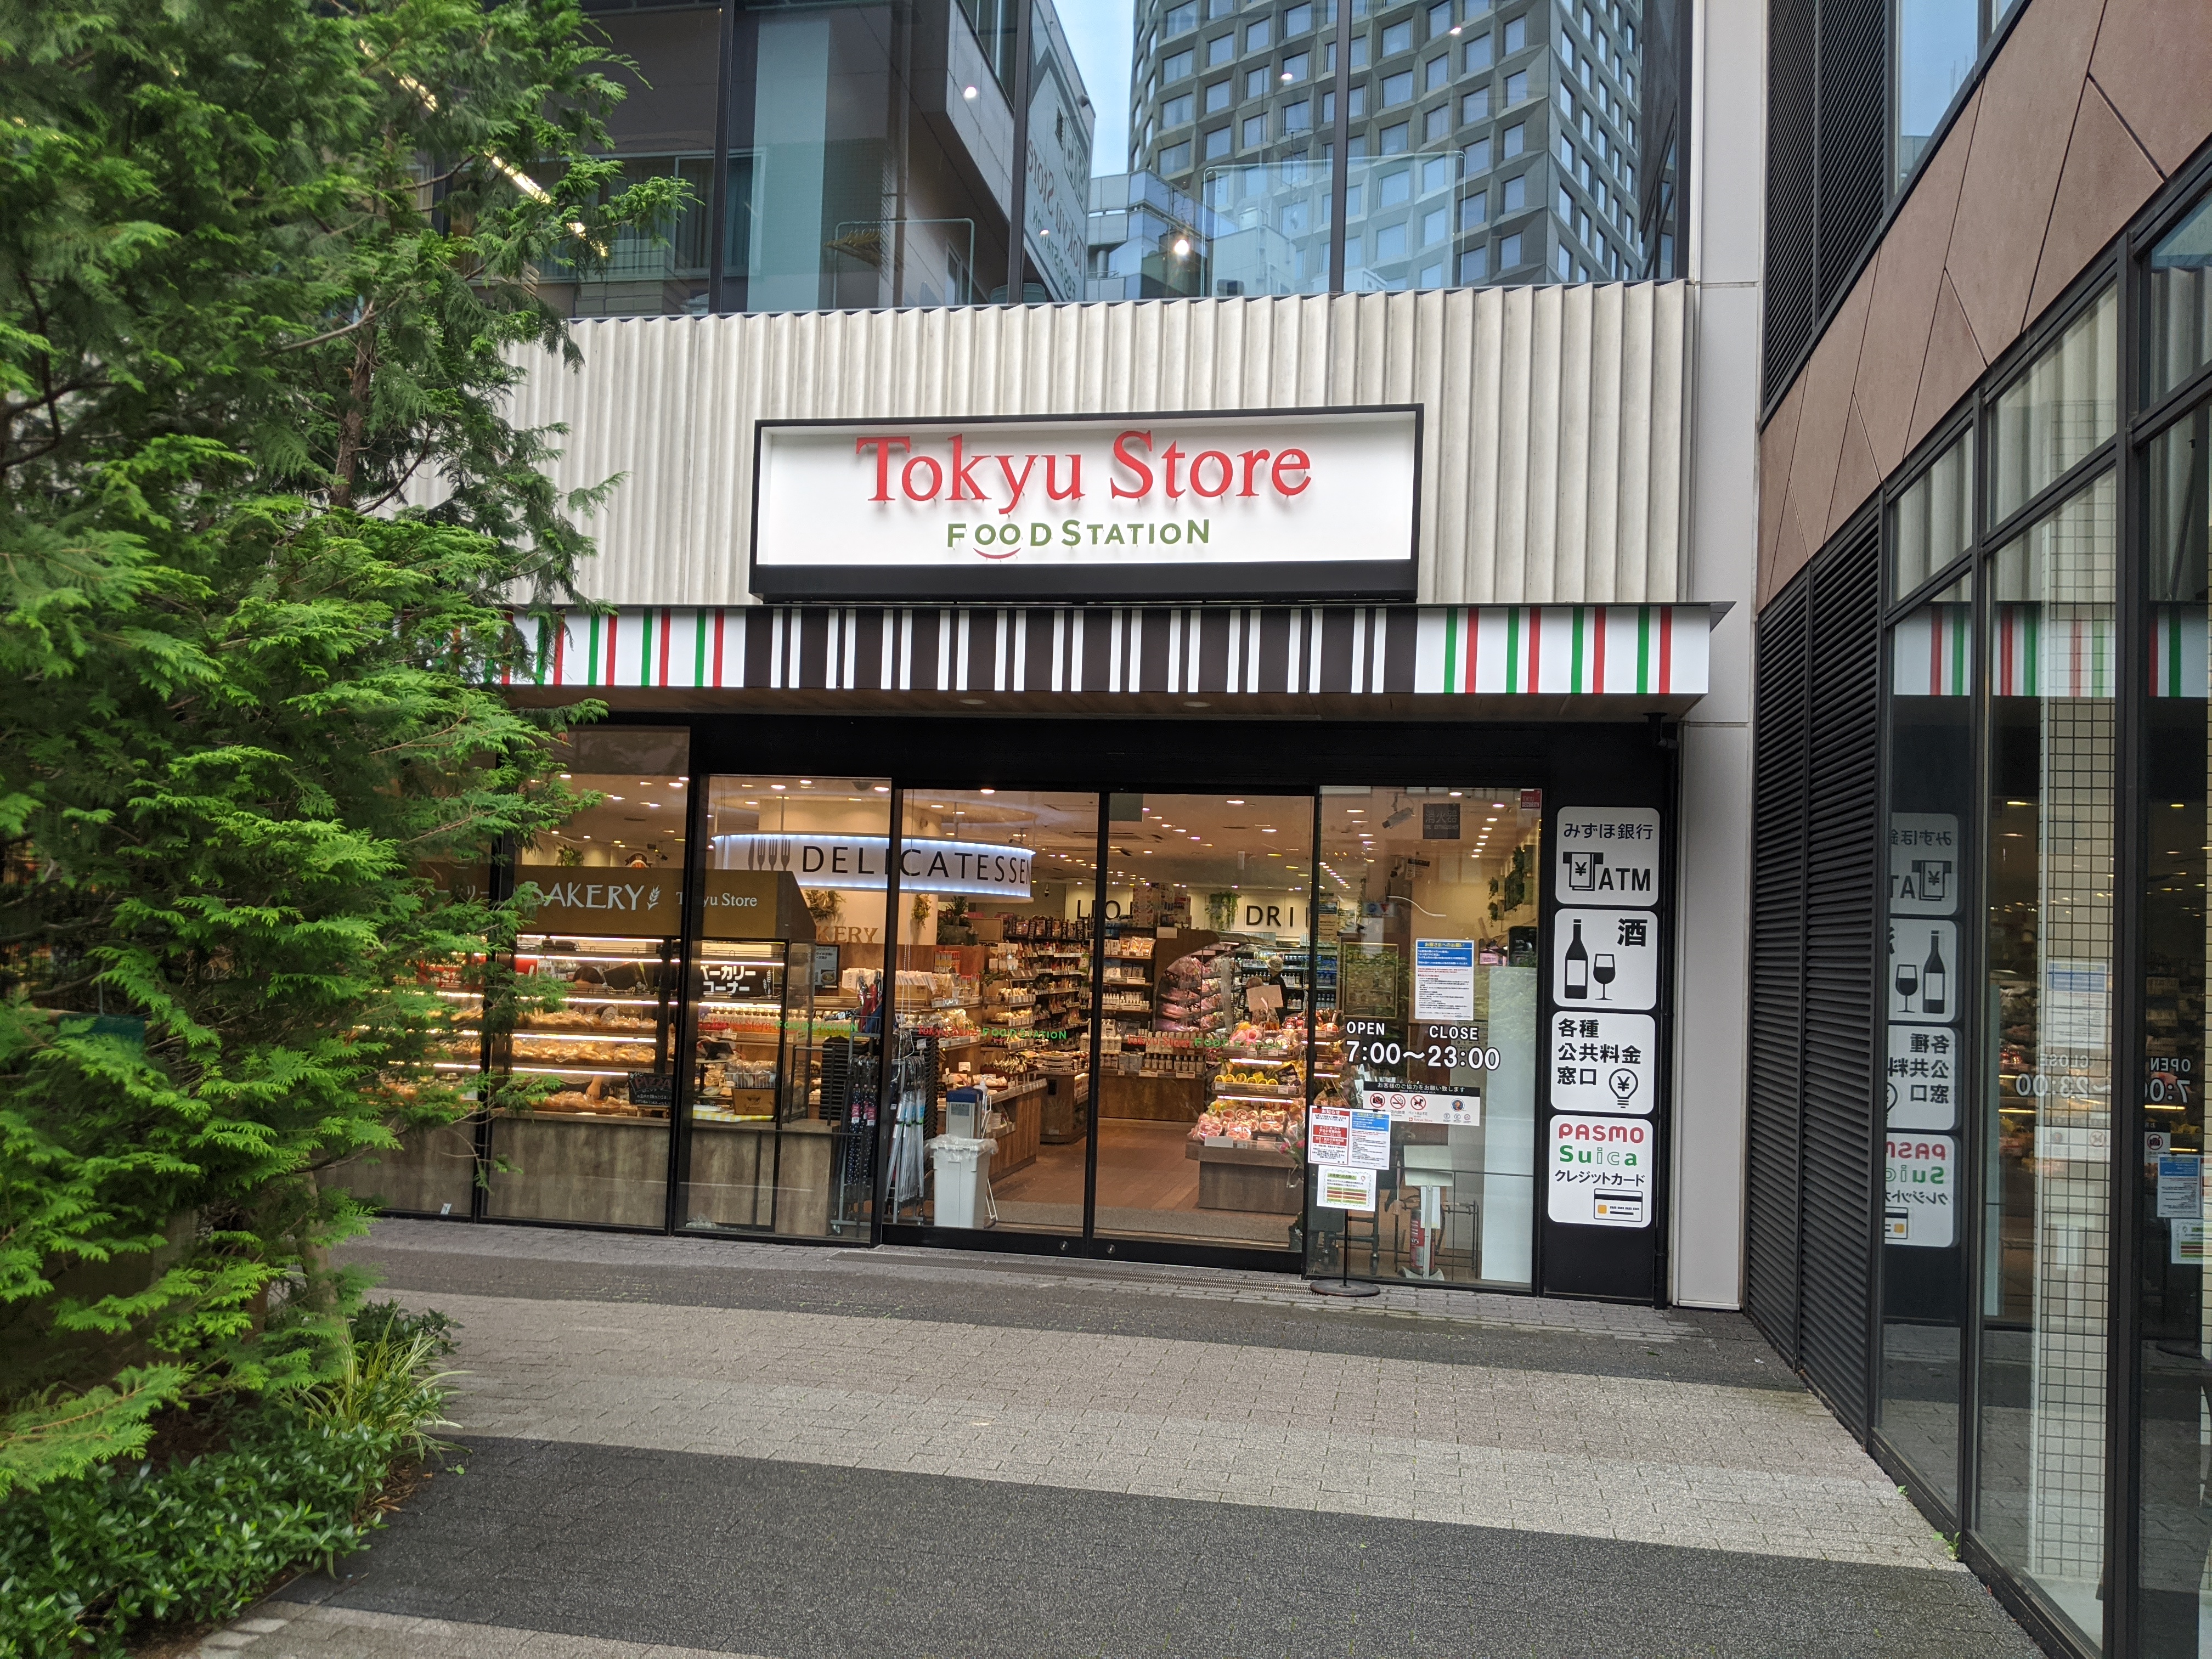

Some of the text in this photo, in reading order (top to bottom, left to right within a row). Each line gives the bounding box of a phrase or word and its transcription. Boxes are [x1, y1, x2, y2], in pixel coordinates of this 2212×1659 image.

[855, 430, 1312, 515] Tokyu Store
[1563, 823, 1654, 840] みずほ銀行
[1598, 867, 1651, 891] ATM
[676, 891, 757, 907] Tyu Store
[1246, 905, 1309, 927] DRI
[1616, 918, 1647, 947] 酒
[703, 981, 750, 995] コーナー
[1346, 1022, 1479, 1040] OPEN CLOSE
[1558, 1018, 1599, 1039] 各種
[1558, 1042, 1641, 1064] 公共料金
[1557, 1065, 1597, 1086] 窓口
[1377, 1082, 1466, 1092] お客様のご協力をお願い致します
[1558, 1122, 1644, 1144] PASMO
[1559, 1144, 1638, 1167] Suica
[1554, 1169, 1645, 1188] クレジットカード
